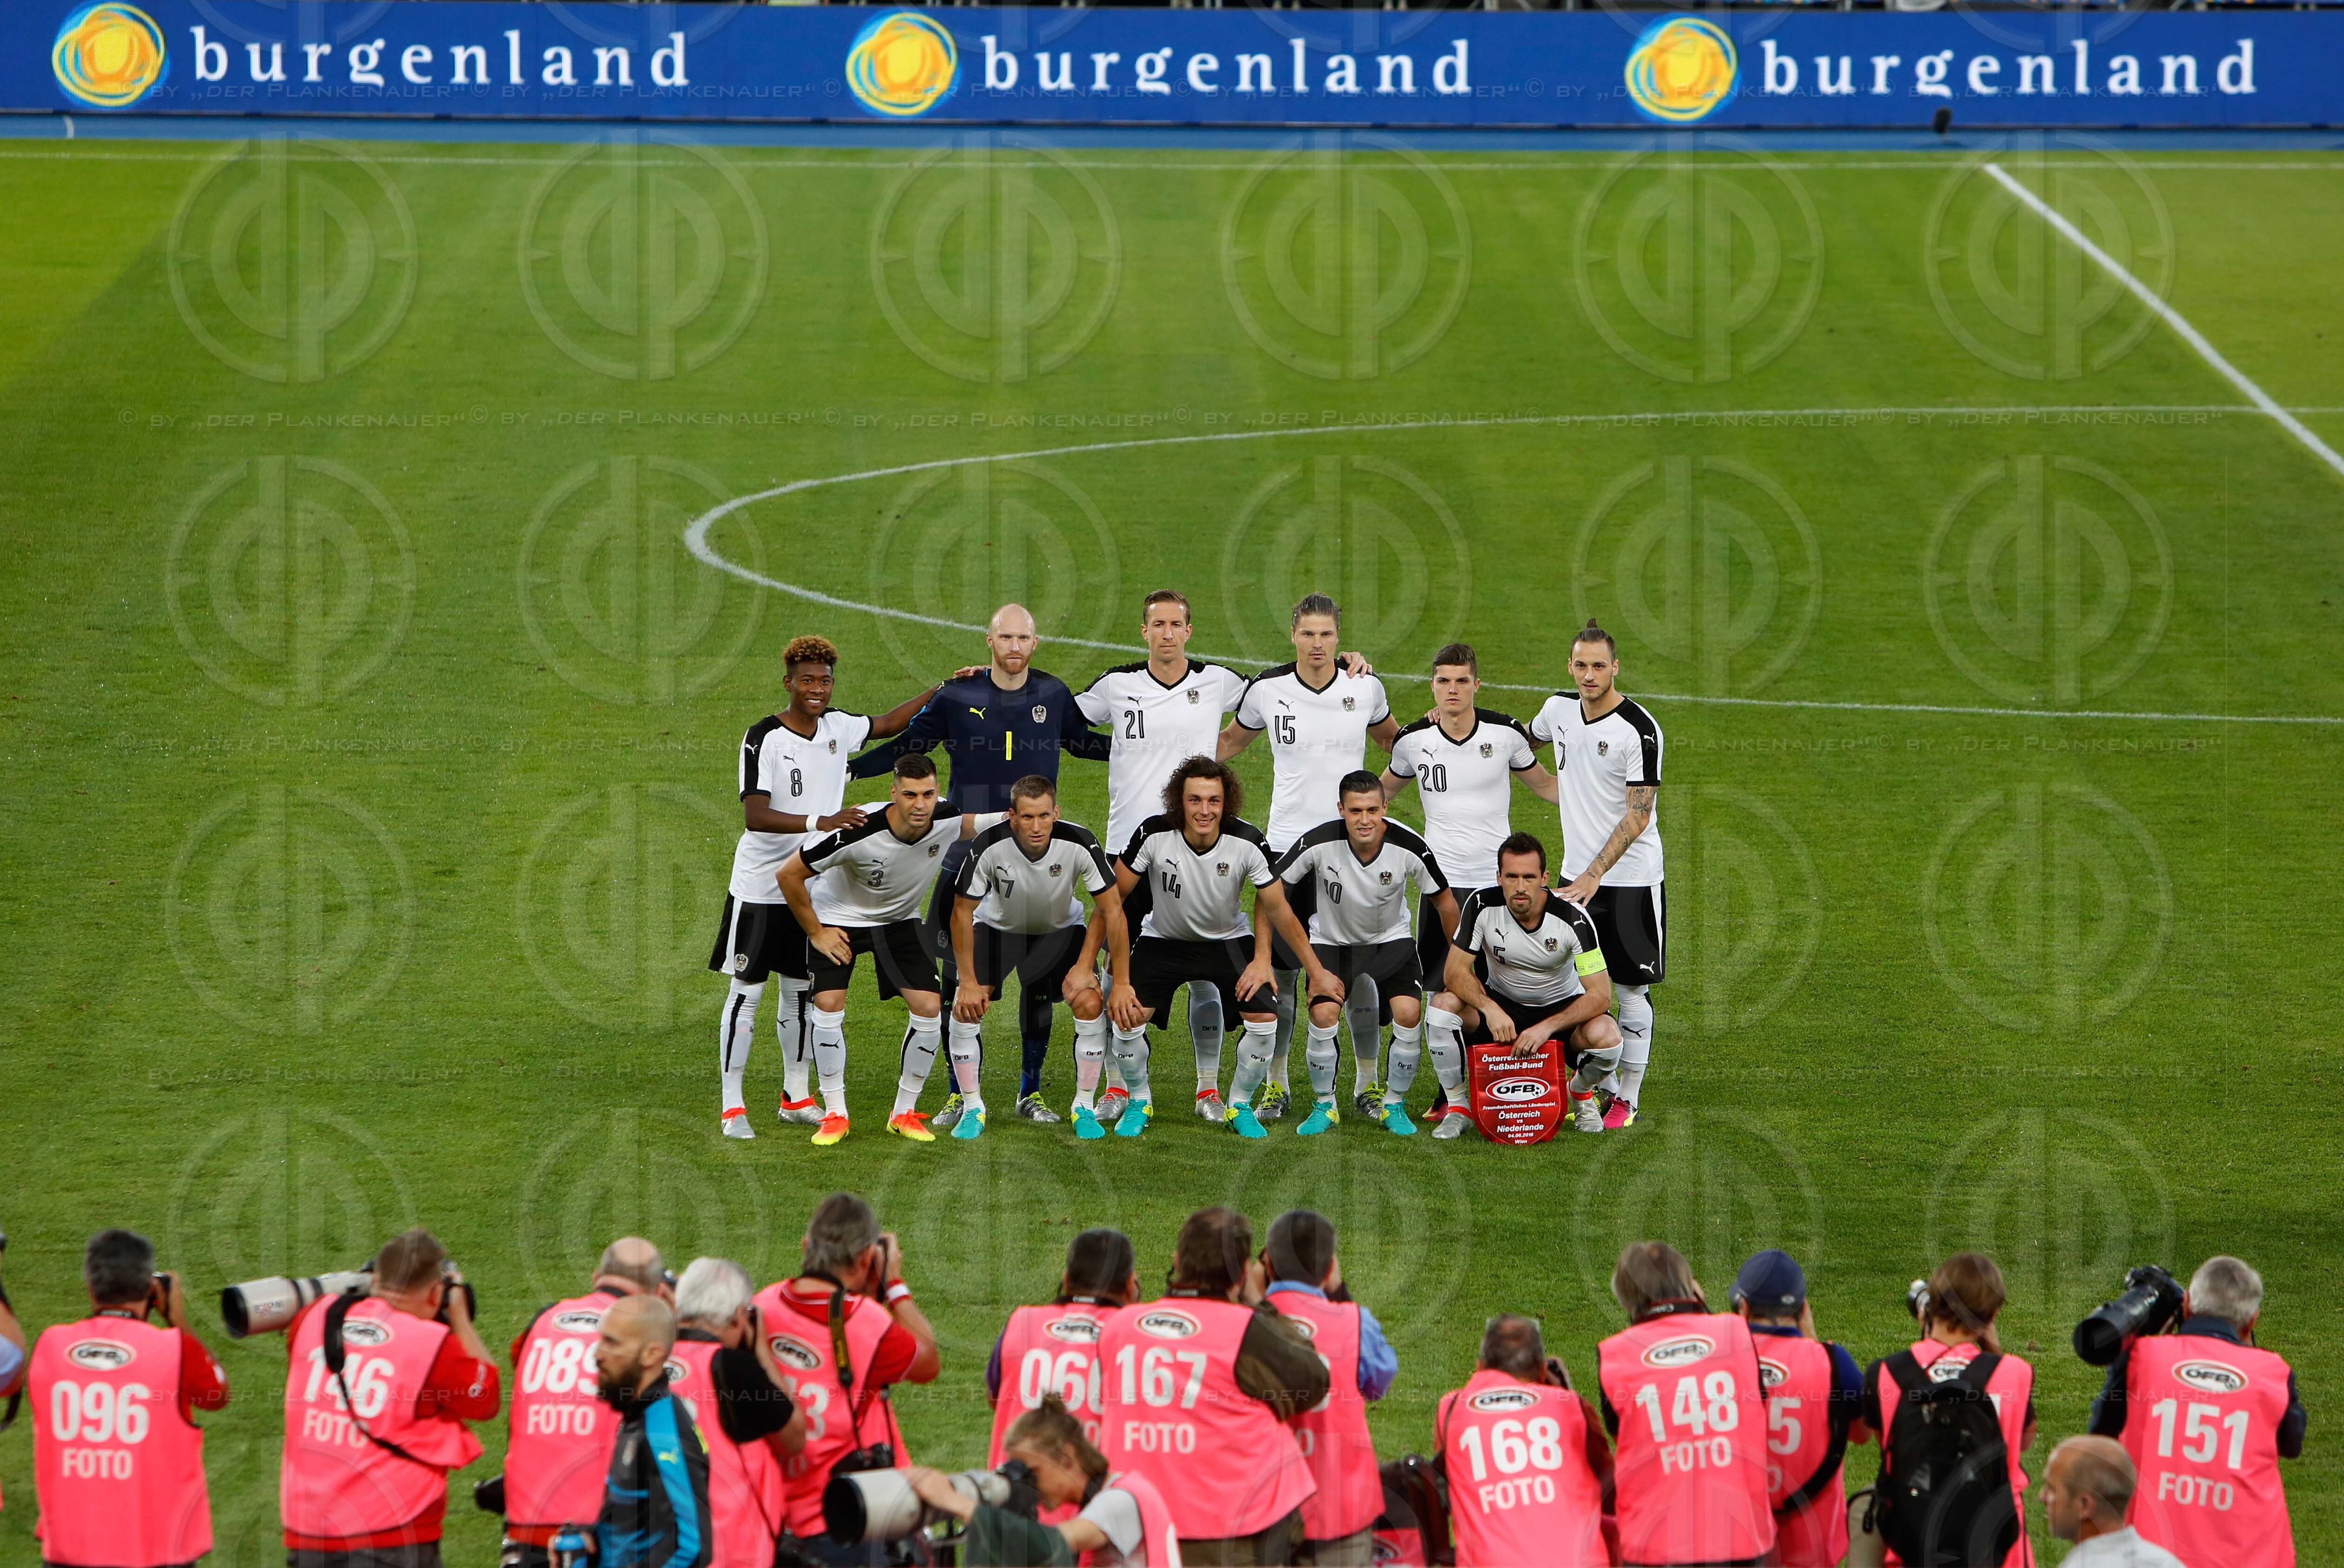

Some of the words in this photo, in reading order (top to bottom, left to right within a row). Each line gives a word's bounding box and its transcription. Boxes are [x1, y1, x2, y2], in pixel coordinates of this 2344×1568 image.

[191, 26, 689, 86] burgenland
[981, 36, 1471, 94] burgenland
[1761, 39, 2255, 97] burgenland
[1124, 710, 1145, 739] 21
[1274, 715, 1296, 744] 15
[1005, 731, 1012, 761] 1
[1558, 741, 1566, 771] 7
[790, 768, 803, 797] 8
[1418, 764, 1447, 792] 20
[867, 870, 884, 888] 3
[995, 878, 1015, 899] 17
[1162, 871, 1182, 899] 14
[1323, 878, 1342, 904] 10
[1493, 946, 1506, 964] 5
[1489, 1061, 1543, 1071] Fußball-Bund
[1497, 1123, 1544, 1133] Niederlande
[1498, 1110, 1540, 1119] Österreich
[304, 1346, 395, 1419] 146
[1116, 1343, 1206, 1409] 167
[51, 1380, 150, 1445] 096
[526, 1403, 596, 1436] FOTO
[1635, 1370, 1738, 1442] 148
[1124, 1421, 1195, 1454] FOTO
[1458, 1416, 1563, 1482] 168
[2151, 1397, 2250, 1469] 151
[62, 1448, 133, 1480] FOTO
[1659, 1436, 1732, 1475] FOTO
[1478, 1475, 1555, 1515] FOTO
[2158, 1471, 2234, 1511] FOTO
